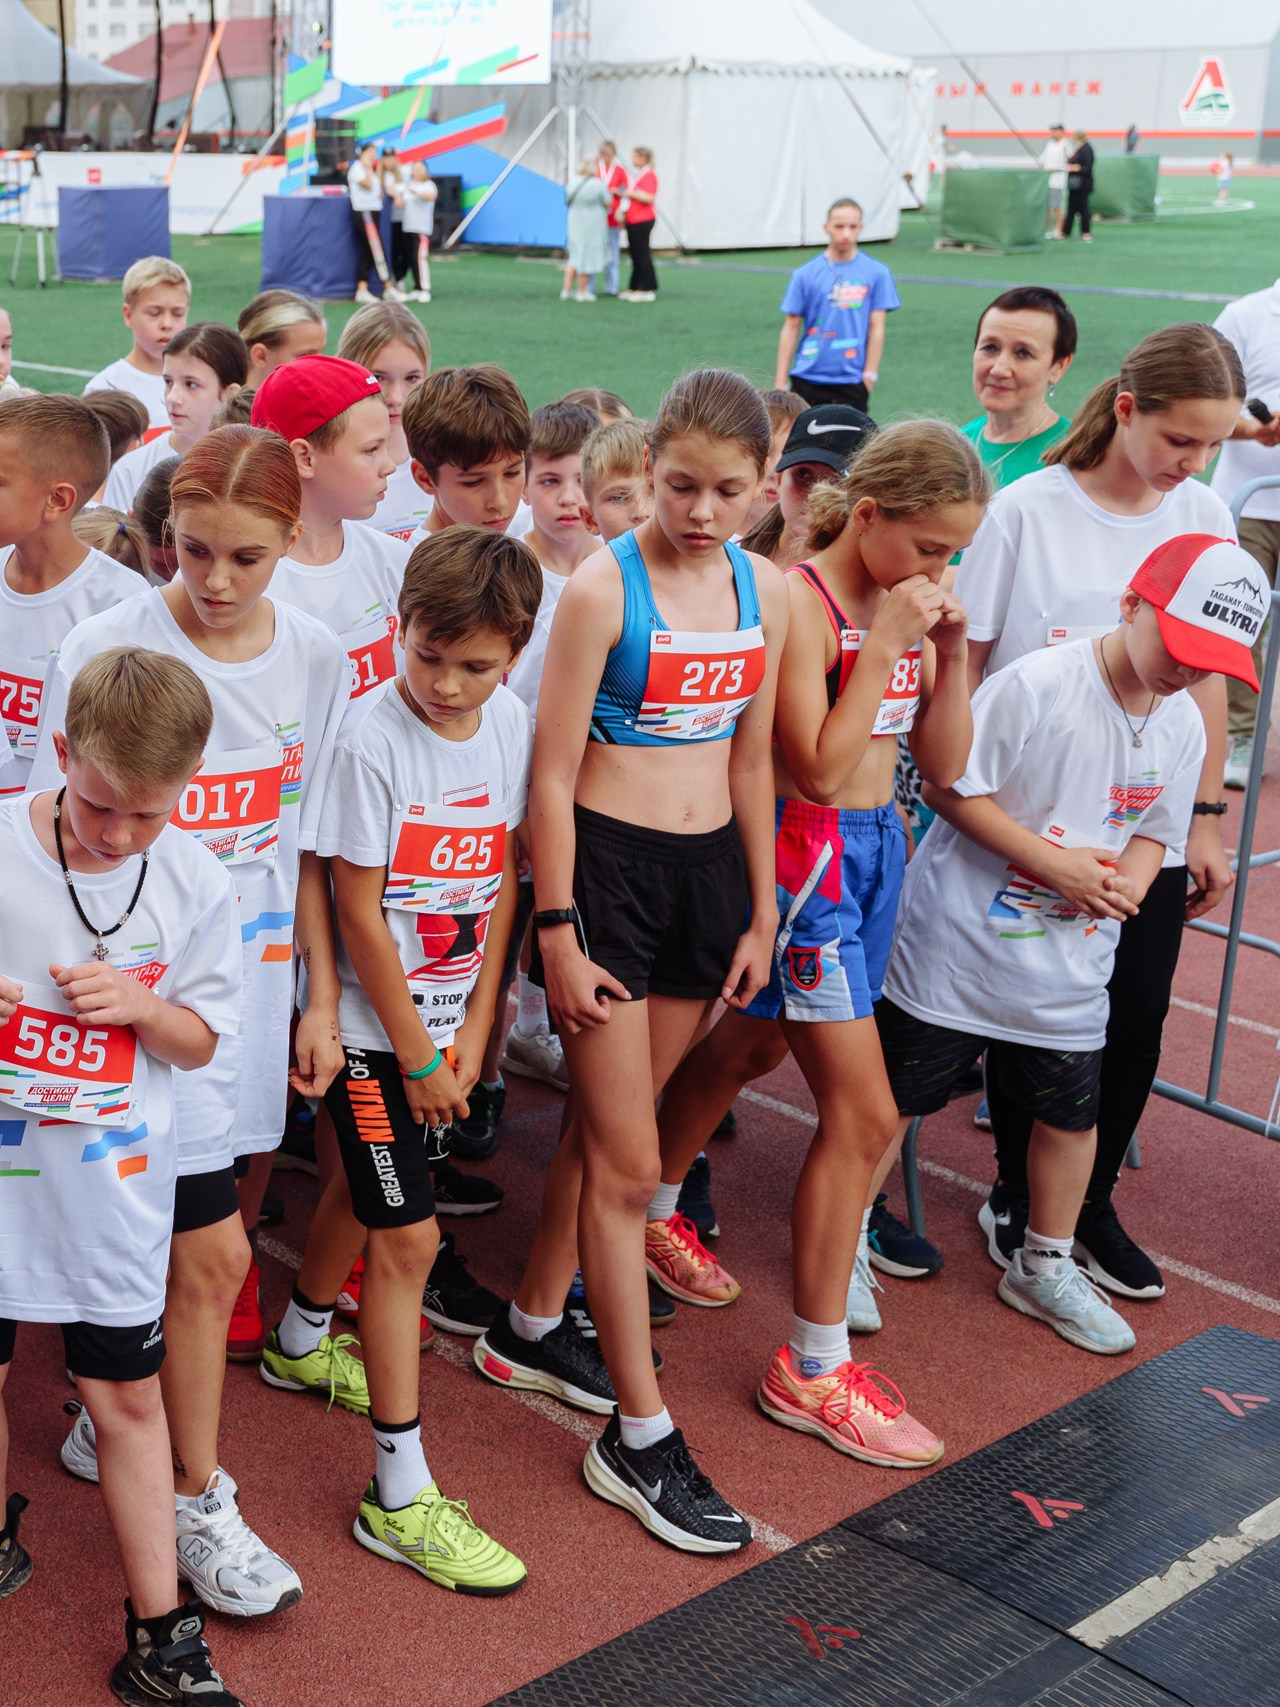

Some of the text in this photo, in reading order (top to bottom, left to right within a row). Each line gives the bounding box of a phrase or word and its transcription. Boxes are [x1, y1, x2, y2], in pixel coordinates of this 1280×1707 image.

[1201, 599, 1259, 637] ULTRA
[680, 658, 746, 696] 273
[886, 658, 922, 692] 83
[178, 779, 256, 823] 017
[204, 835, 236, 850] ОСТИГАЯ
[429, 834, 494, 871] 625
[432, 993, 463, 1006] STOP
[14, 1015, 109, 1072] 585
[348, 1059, 370, 1080] OF
[30, 1087, 76, 1095] ДОСТИГАЯ
[43, 1094, 72, 1103] ЦЕЛИ!
[346, 1079, 396, 1142] NINJA
[370, 1143, 405, 1207] GREATEST
